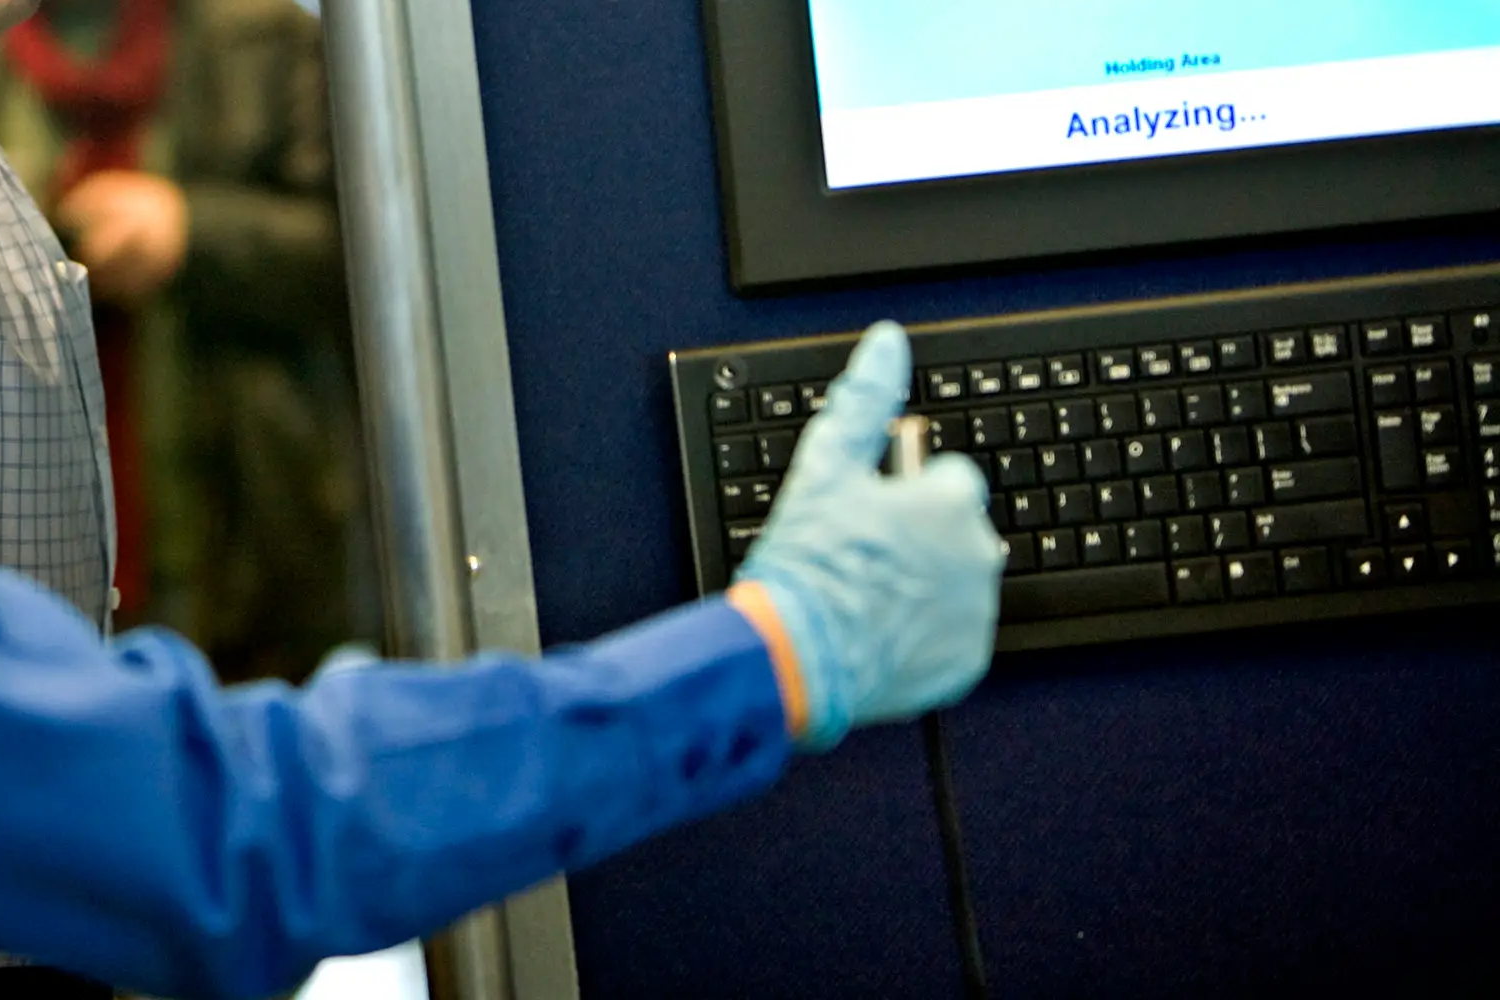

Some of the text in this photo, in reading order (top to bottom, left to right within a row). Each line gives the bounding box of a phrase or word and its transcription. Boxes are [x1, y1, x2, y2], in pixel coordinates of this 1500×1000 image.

[1104, 53, 1222, 76] Holding Area
[1066, 100, 1267, 139] Analyzing...
[1128, 441, 1144, 457] O
[1000, 454, 1012, 470] Y
[1042, 451, 1056, 467] U
[1100, 486, 1113, 503] K
